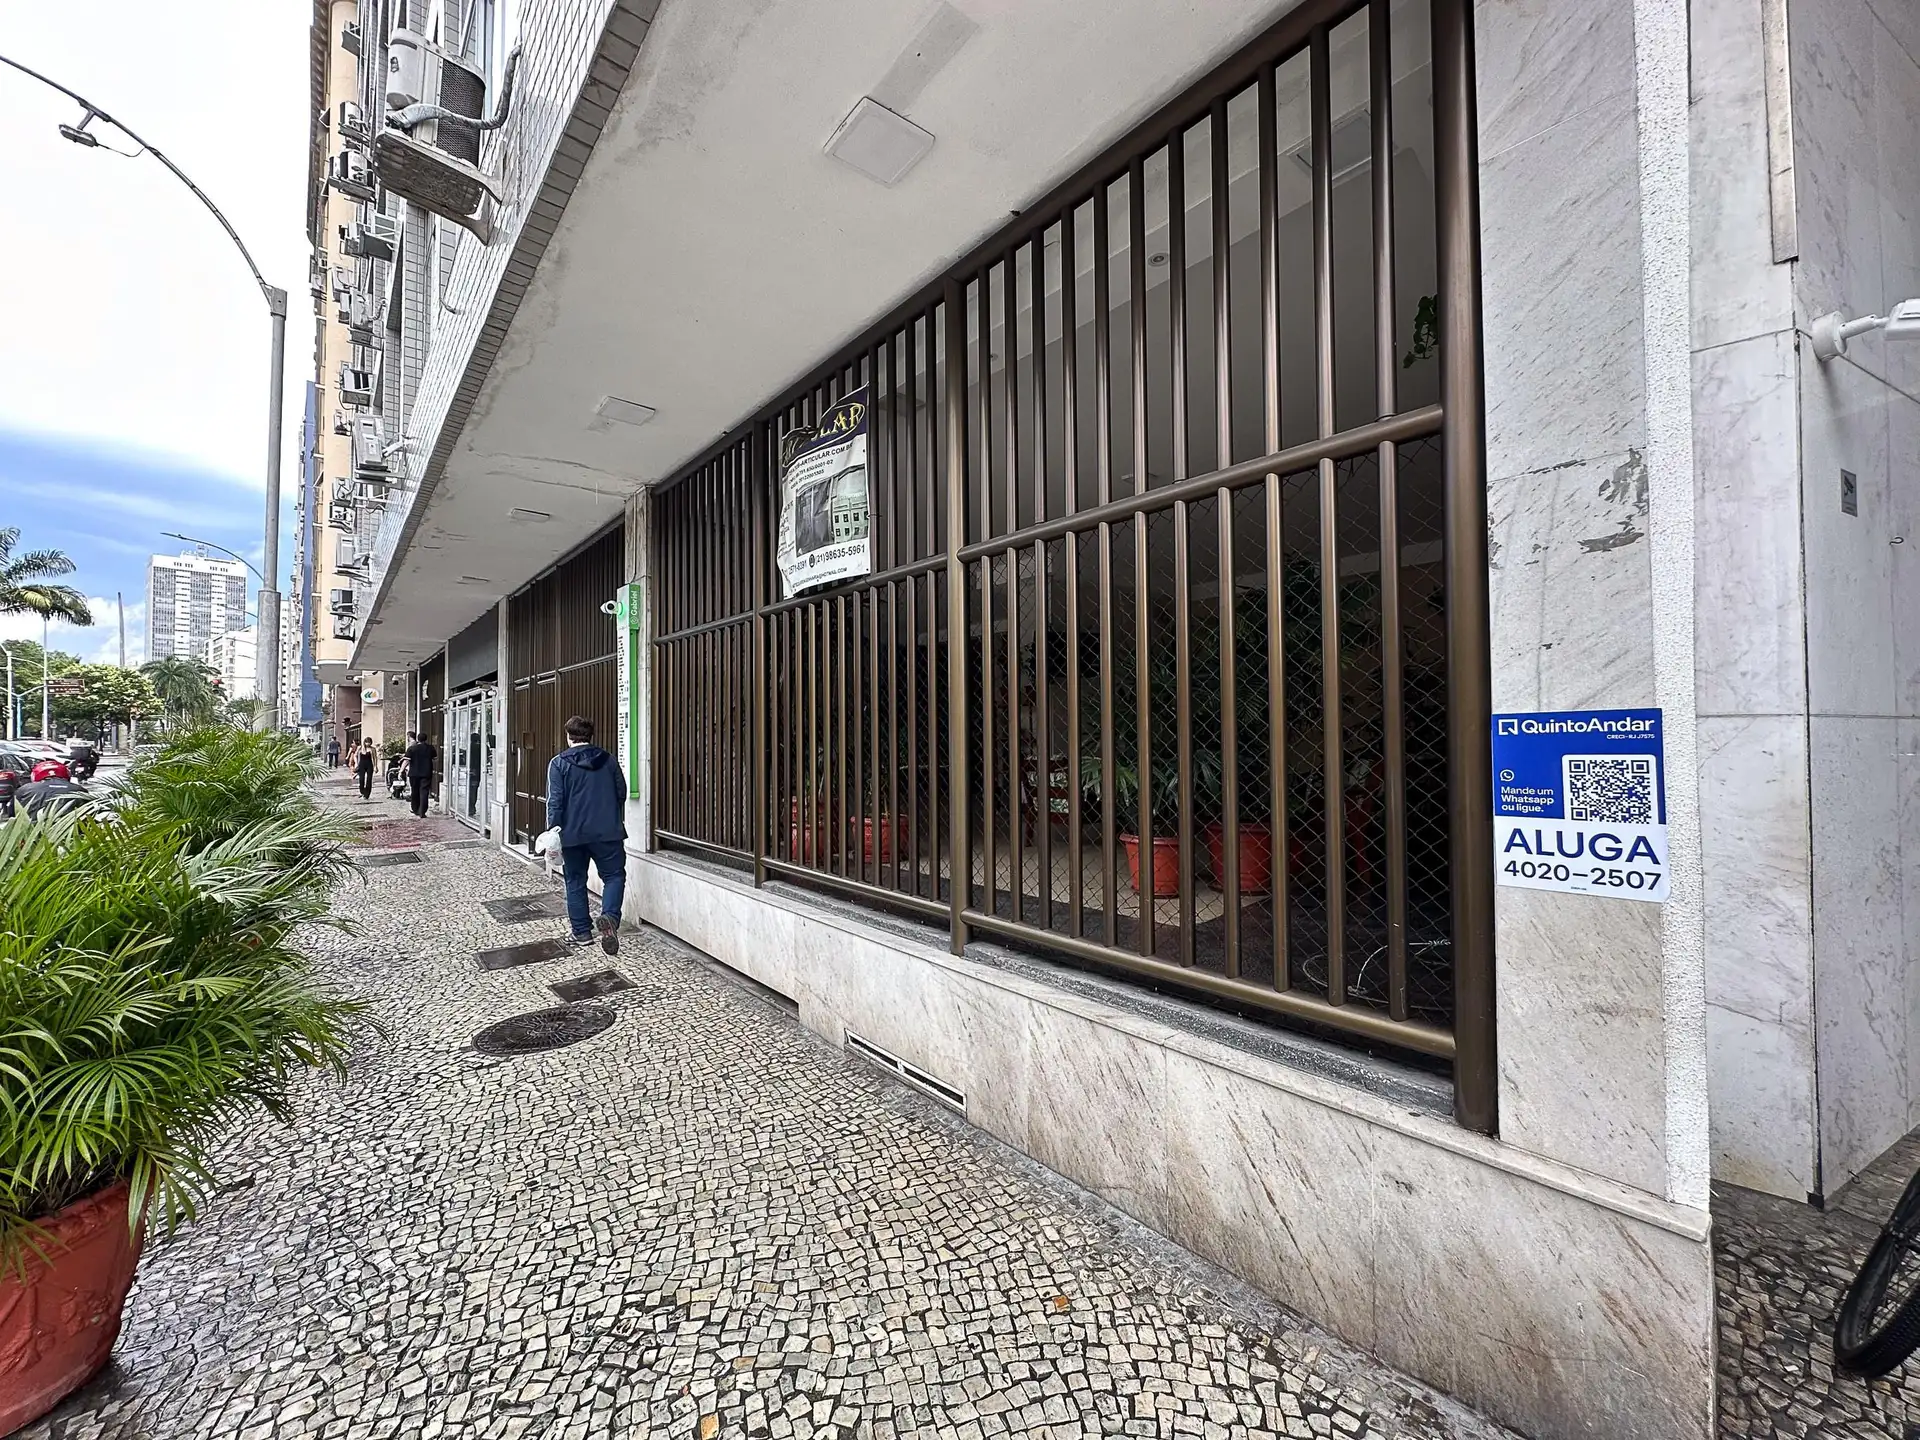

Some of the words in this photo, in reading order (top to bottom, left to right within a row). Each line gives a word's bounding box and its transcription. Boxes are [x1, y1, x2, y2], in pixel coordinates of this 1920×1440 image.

[630, 591, 638, 616] Gabriel
[1521, 717, 1655, 734] QuintoAndar
[1501, 786, 1535, 795] Mande
[1537, 788, 1554, 796] um
[1501, 795, 1554, 806] Whatsapp
[1516, 803, 1544, 813] ligue.
[1503, 828, 1661, 865] ALUGA
[1504, 860, 1662, 890] 4020-2507
